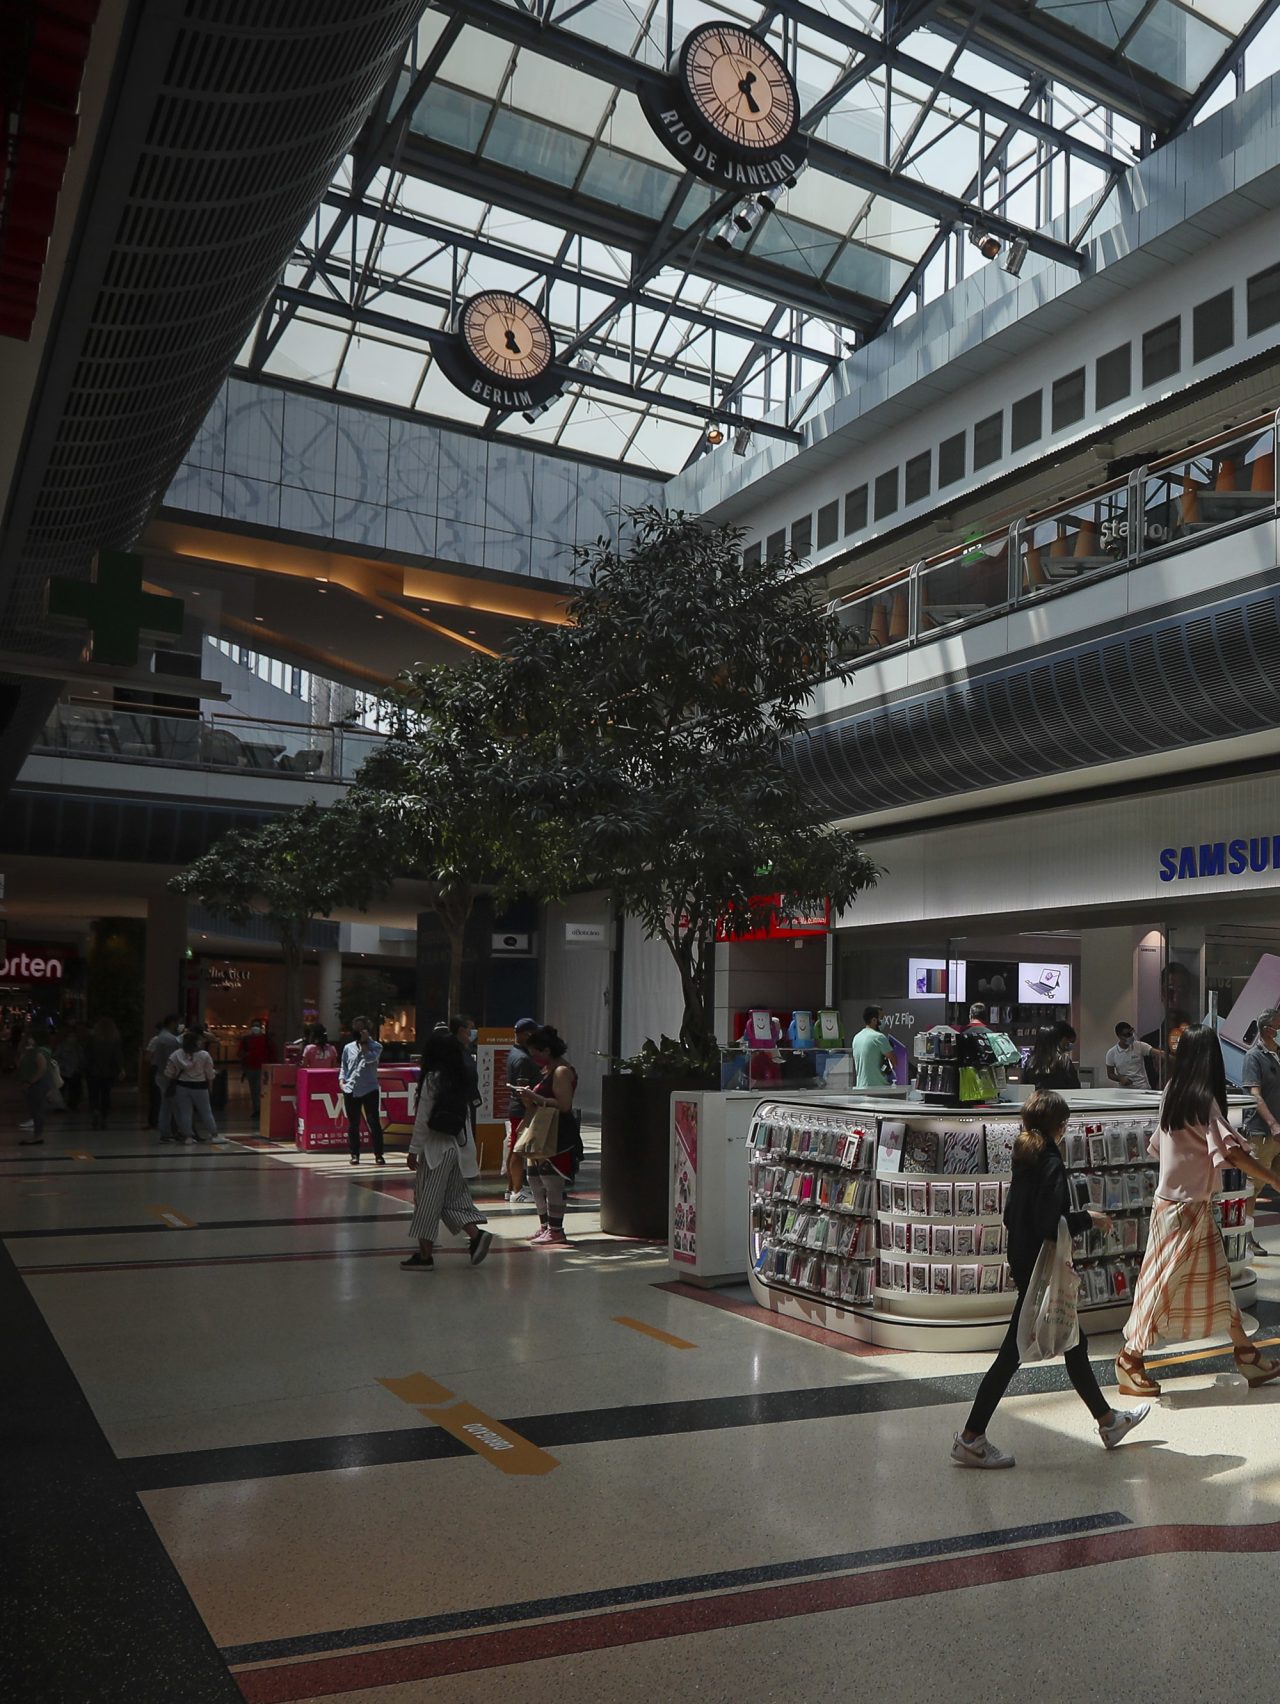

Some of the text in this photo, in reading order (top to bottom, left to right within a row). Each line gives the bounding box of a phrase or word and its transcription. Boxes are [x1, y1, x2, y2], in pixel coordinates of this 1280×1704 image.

[660, 109, 796, 185] RIO DE JANEIRO
[471, 379, 533, 406] BERLIM
